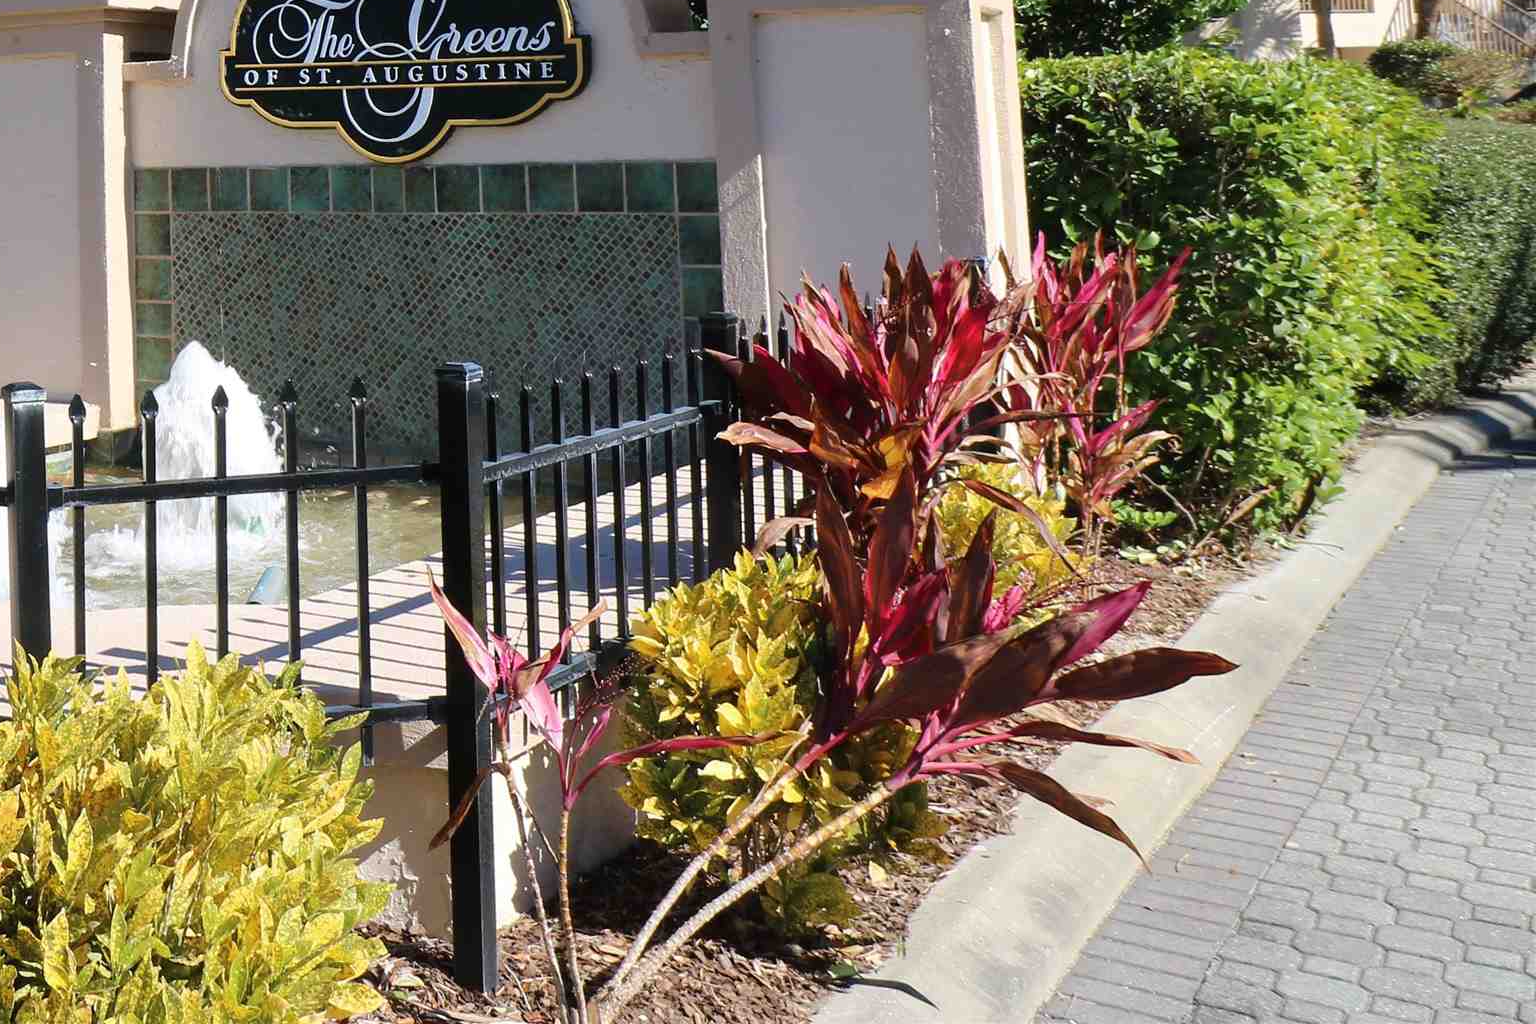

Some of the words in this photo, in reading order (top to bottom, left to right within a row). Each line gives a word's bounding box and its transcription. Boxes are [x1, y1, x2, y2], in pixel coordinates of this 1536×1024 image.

[243, 68, 279, 86] OF
[298, 67, 341, 85] ST.
[362, 61, 555, 84] AUGUSTINE
